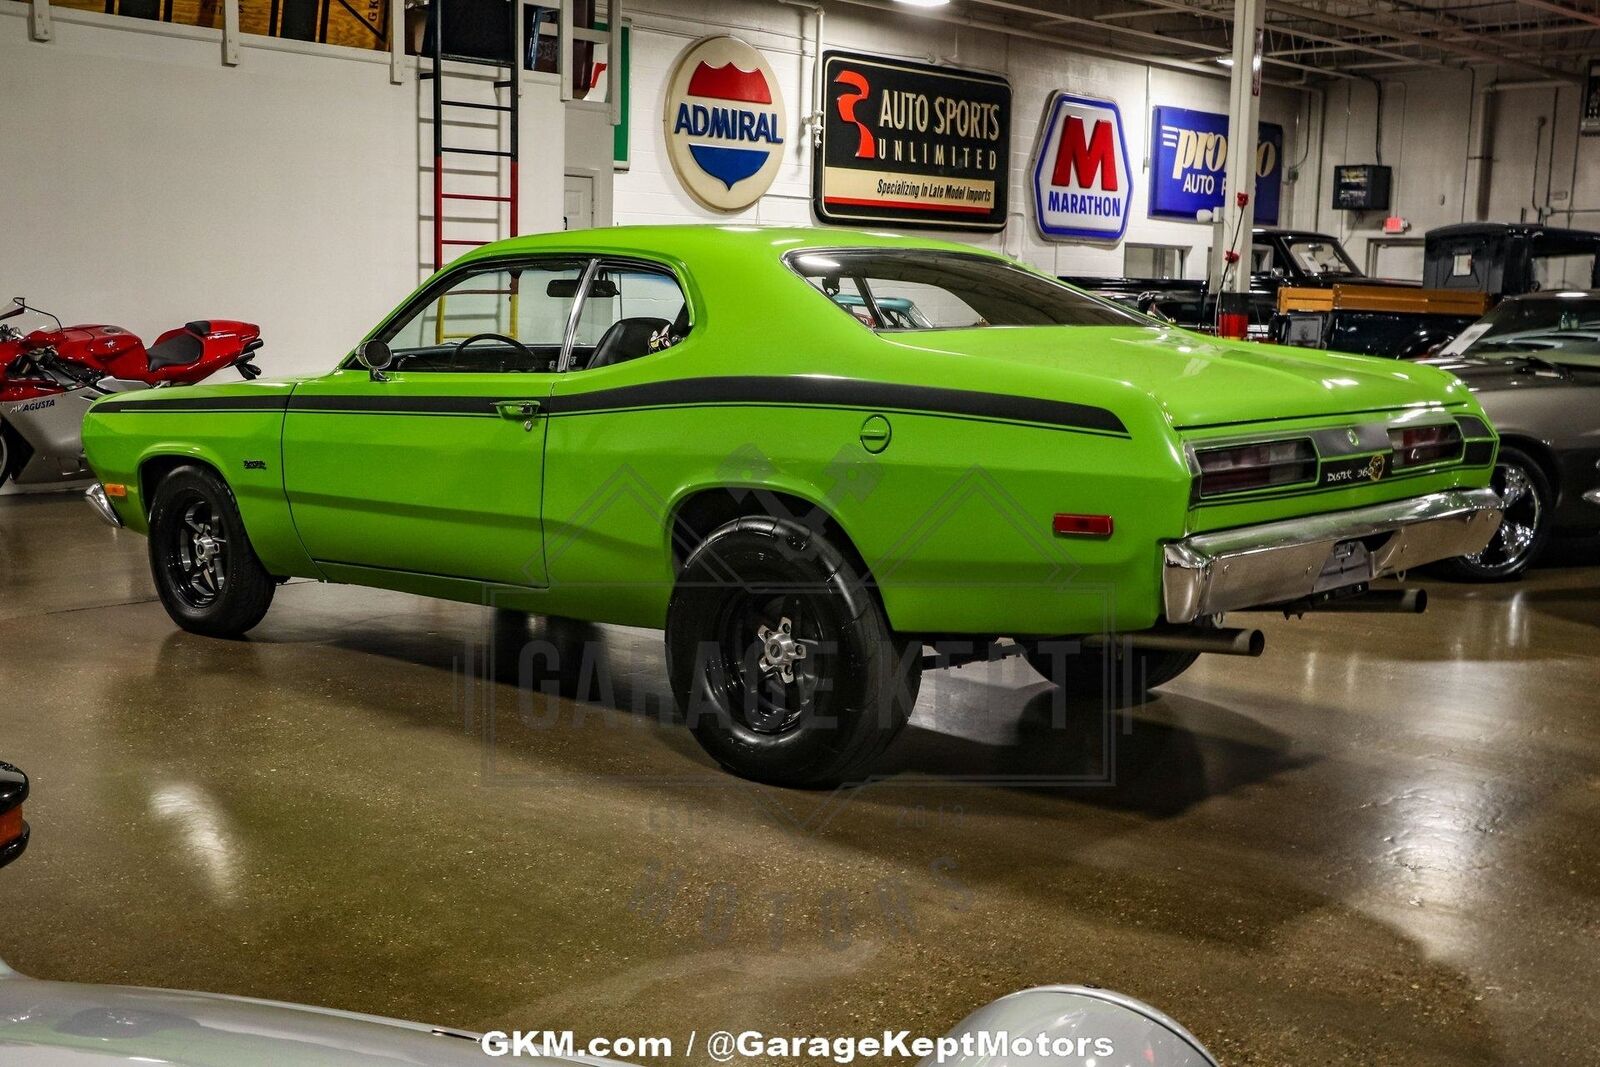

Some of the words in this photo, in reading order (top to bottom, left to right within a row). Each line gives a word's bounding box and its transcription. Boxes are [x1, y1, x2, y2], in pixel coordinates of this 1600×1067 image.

[674, 102, 784, 145] ADMIRAL
[879, 89, 929, 133] AUTO
[934, 97, 1001, 141] SPORTS
[878, 137, 998, 172] UNLIMITED
[1051, 114, 1118, 192] M
[1171, 128, 1275, 180] proo
[876, 178, 920, 200] Specializing
[929, 183, 943, 199] Late
[944, 184, 966, 201] Model
[967, 186, 992, 203] Imports
[1183, 173, 1215, 196] AUTO
[1048, 190, 1121, 218] MARATHON
[23, 399, 55, 412] AGUSTA
